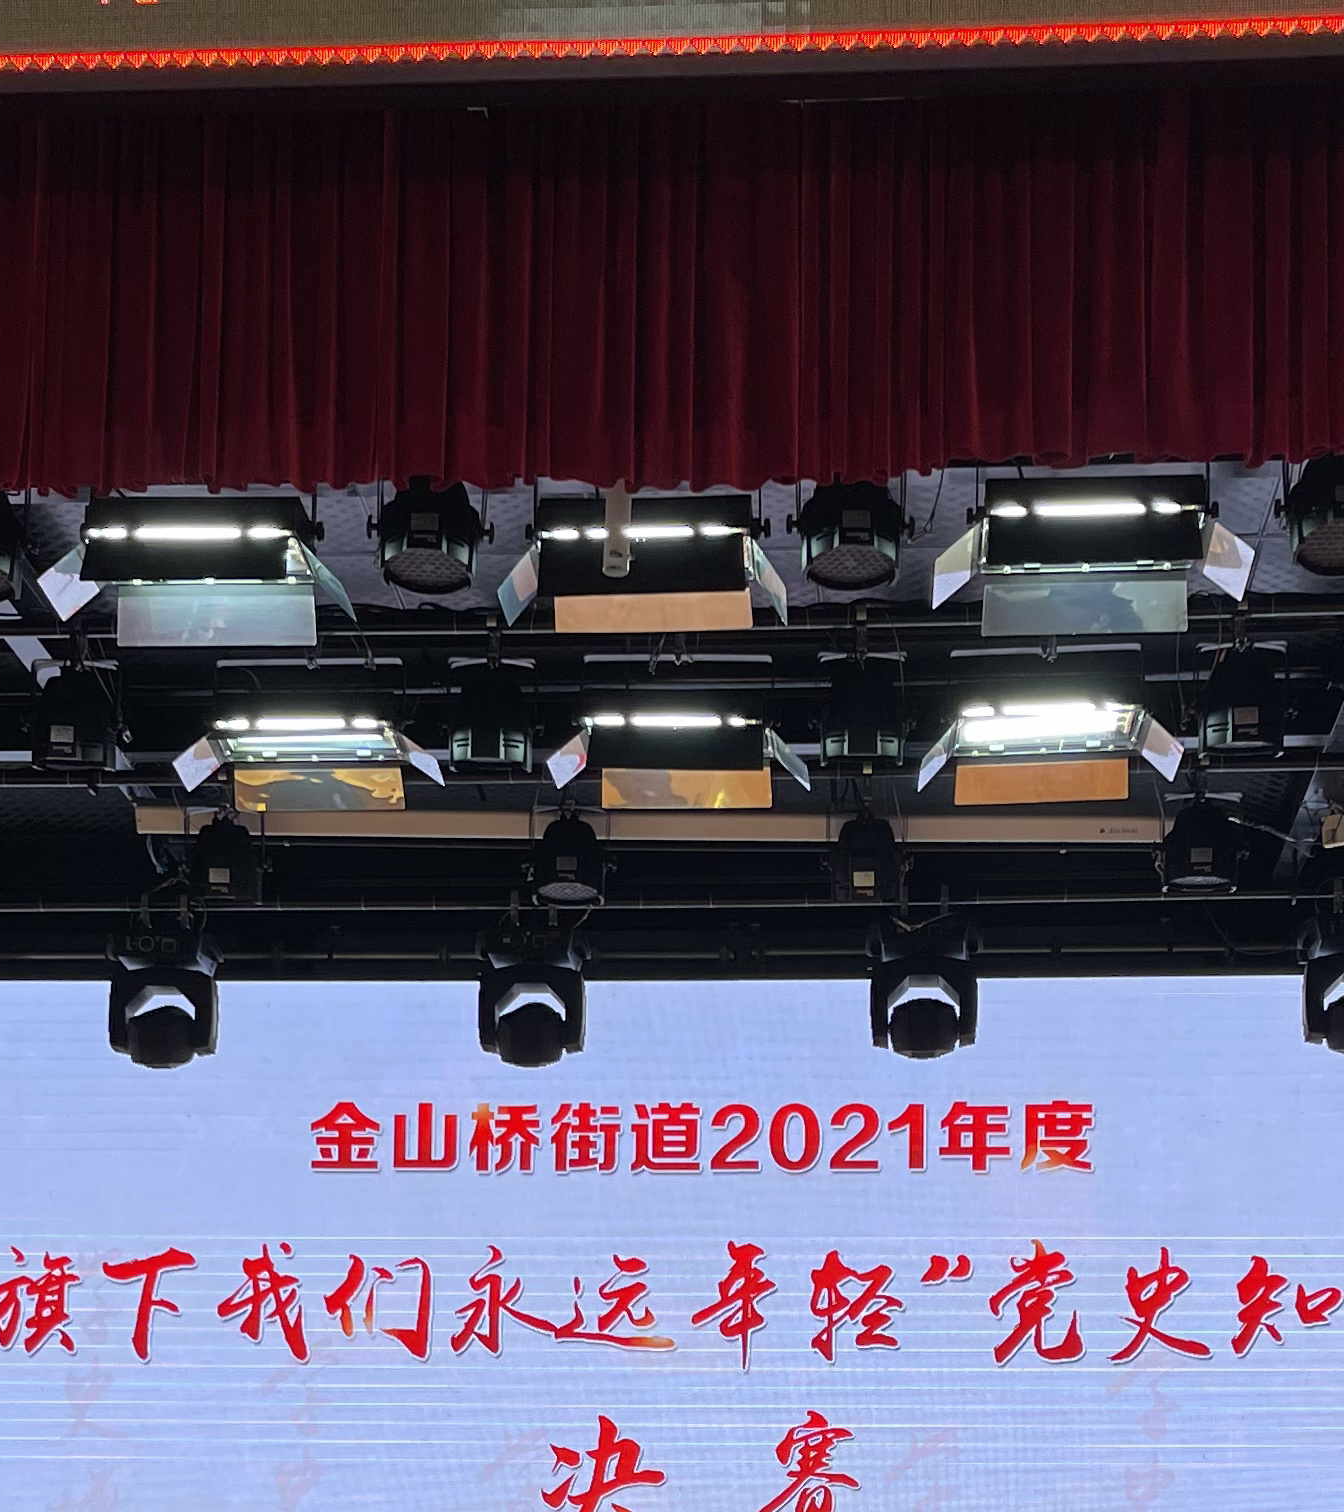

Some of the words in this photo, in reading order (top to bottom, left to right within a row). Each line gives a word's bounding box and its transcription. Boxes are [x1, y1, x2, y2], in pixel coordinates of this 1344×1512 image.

[310, 1100, 1095, 1173] 金山桥街道2021年度
